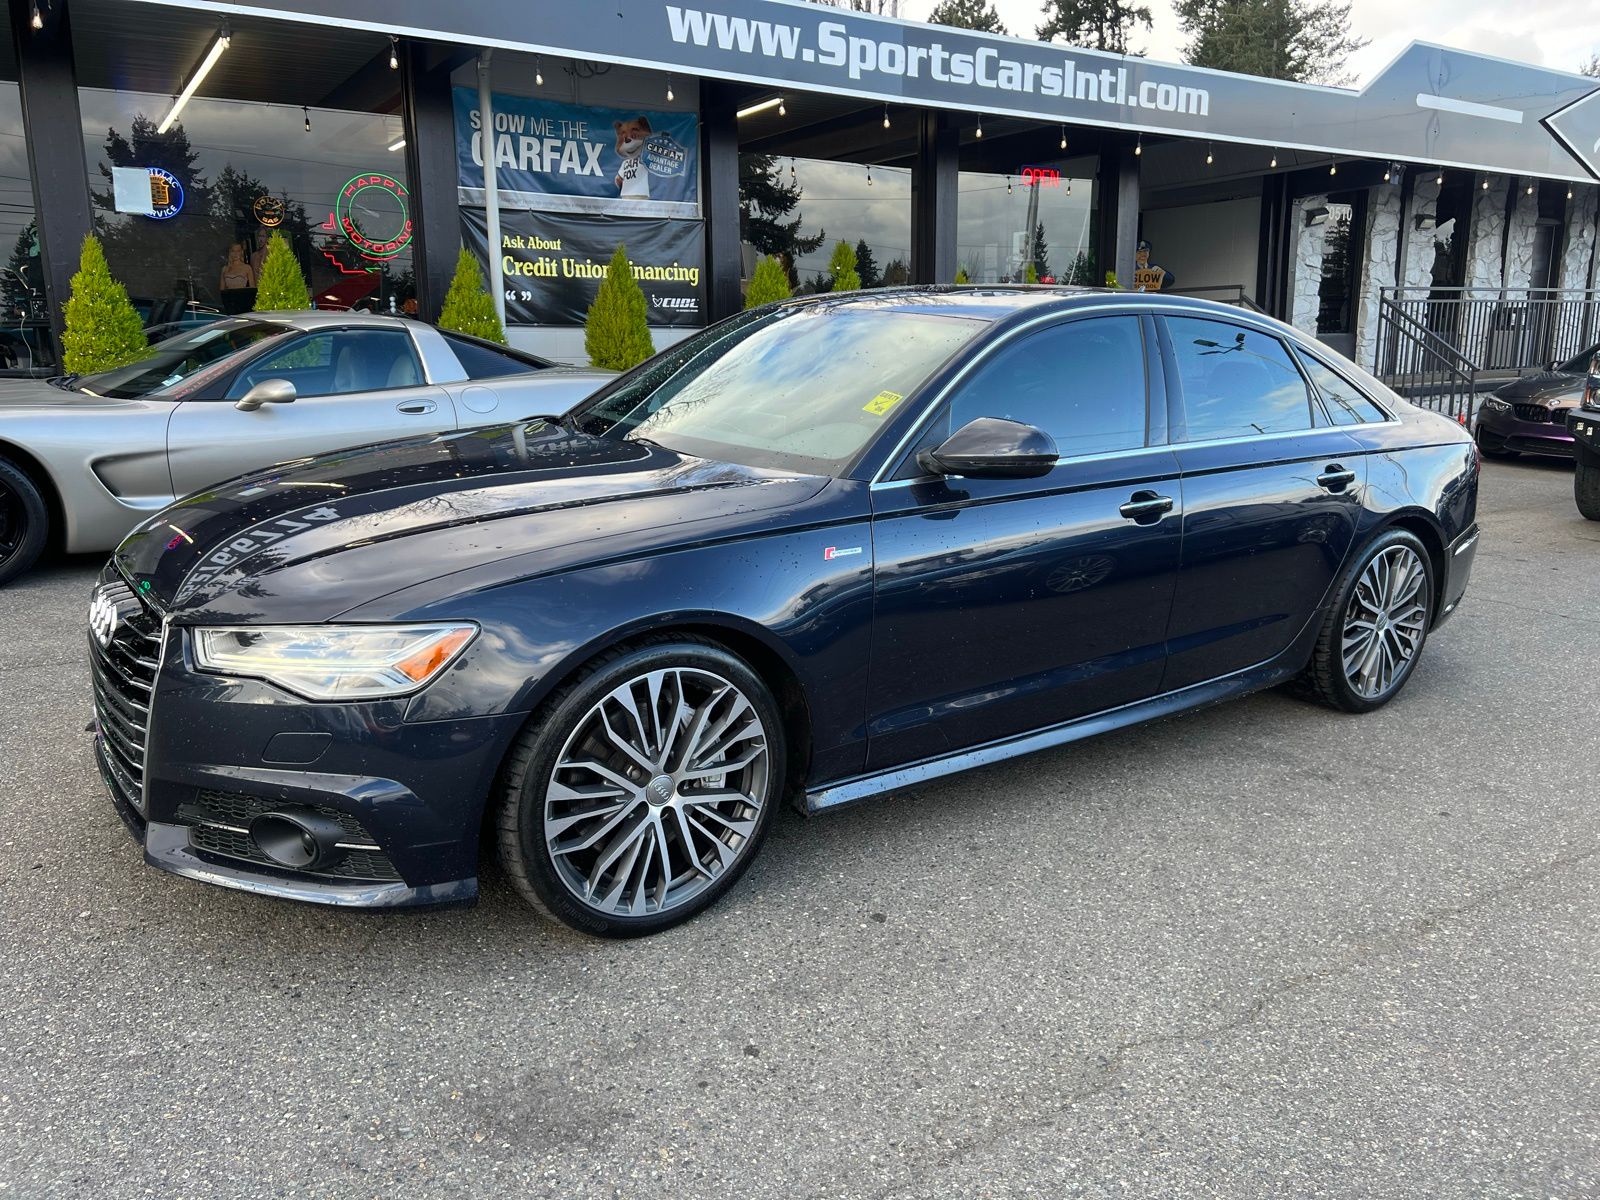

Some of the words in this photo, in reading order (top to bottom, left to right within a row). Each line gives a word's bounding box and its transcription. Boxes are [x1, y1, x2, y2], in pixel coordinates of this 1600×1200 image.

[665, 5, 1209, 117] www.SportsCarsIntl.com
[469, 110, 525, 134] SOW
[530, 117, 555, 137] ME
[558, 120, 588, 140] THE
[471, 130, 605, 177] CARFAX
[646, 153, 679, 169] ADVANTAGE
[647, 143, 684, 161] CARFAX
[623, 157, 639, 171] CAR
[649, 162, 673, 175] DEALER
[623, 168, 638, 180] FOX
[1022, 167, 1060, 189] OPEN
[344, 176, 406, 197] HAPPY
[262, 216, 279, 224] GAS
[502, 235, 525, 249] Ask
[527, 236, 562, 251] About
[502, 255, 559, 277] Credit
[628, 260, 700, 287] inancing
